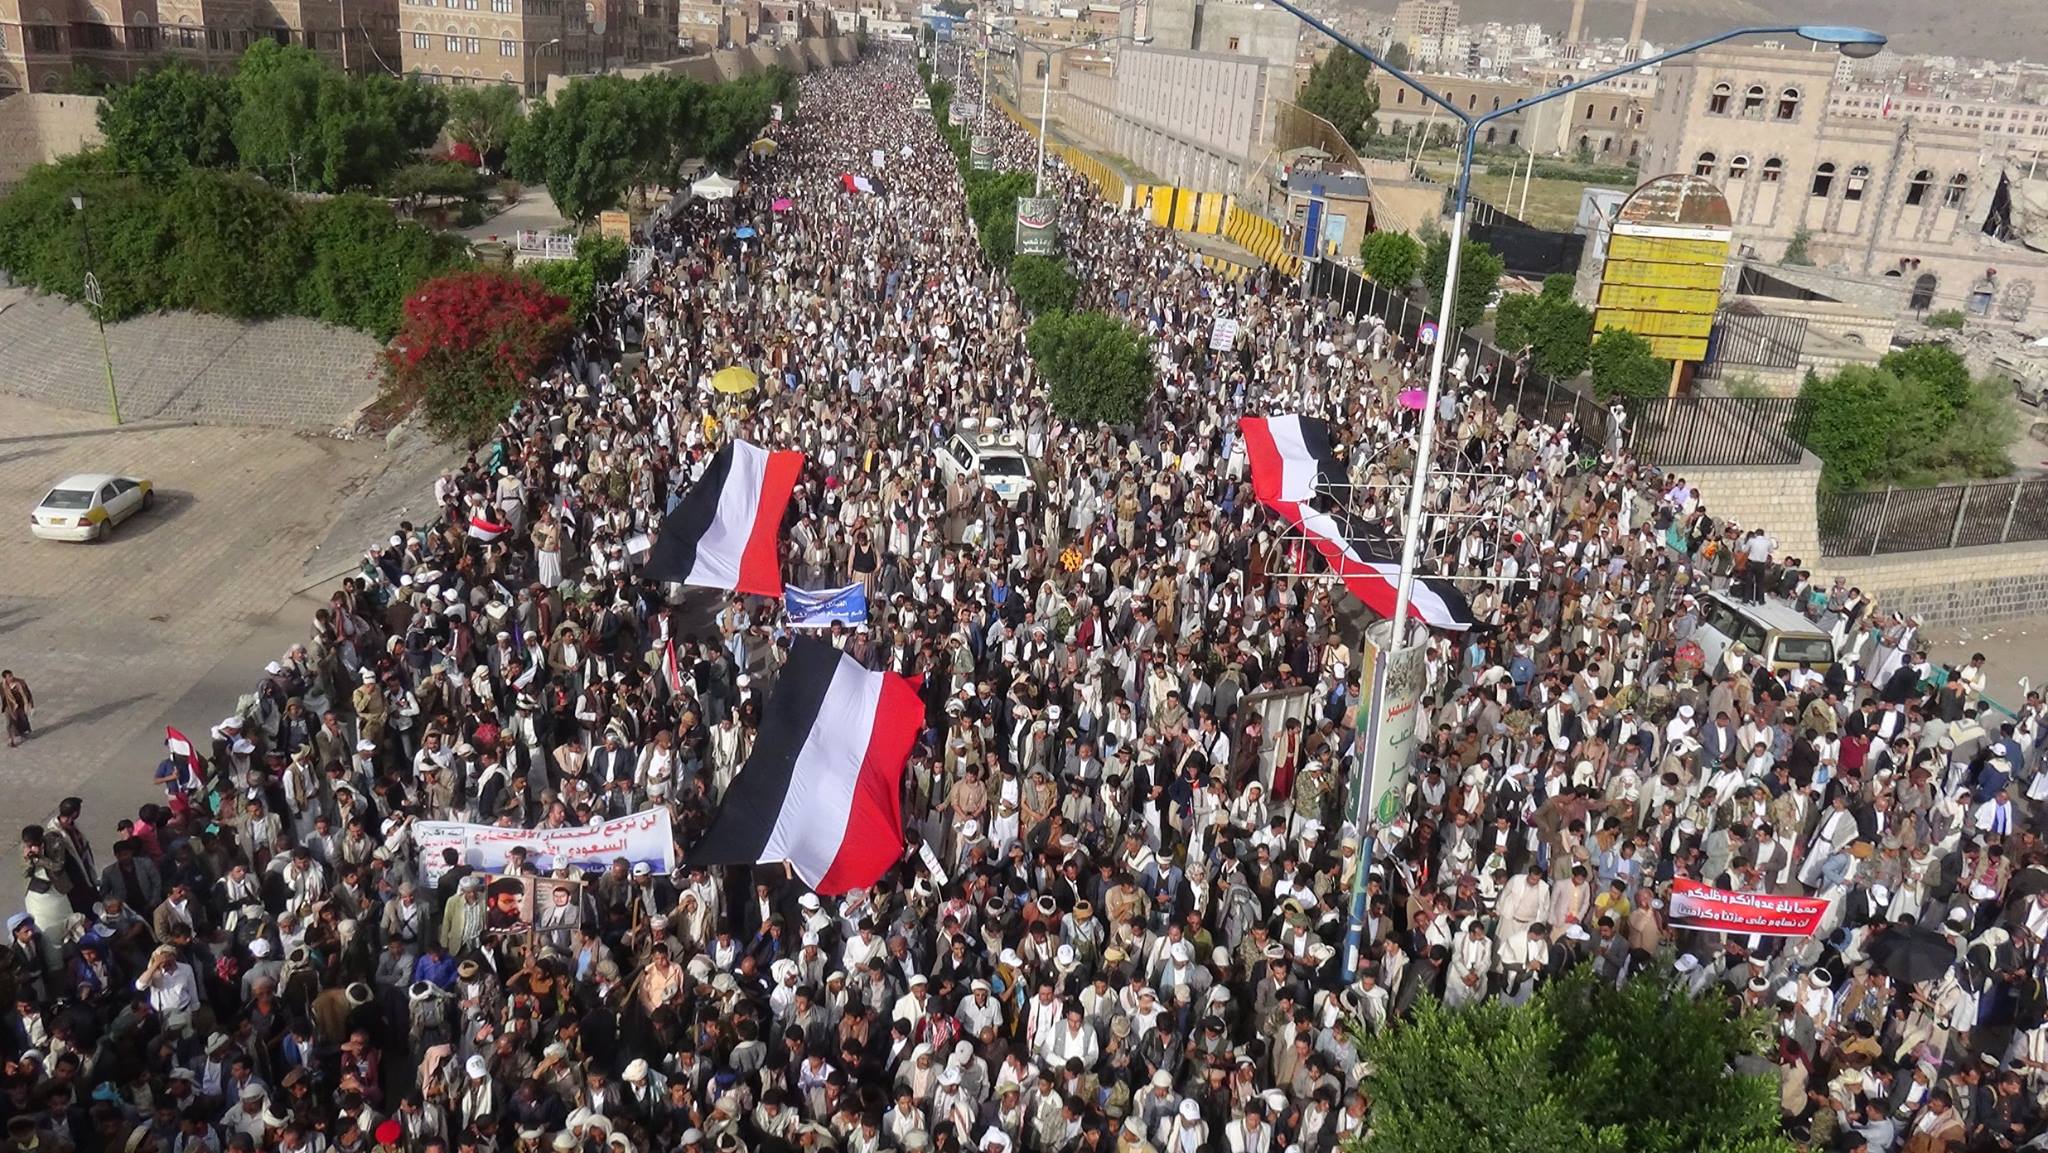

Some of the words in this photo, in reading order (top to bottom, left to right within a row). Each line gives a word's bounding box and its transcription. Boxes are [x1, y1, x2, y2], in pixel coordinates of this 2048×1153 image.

[604, 818, 636, 837] نركع
[640, 814, 657, 831] لن
[543, 826, 600, 842] للحصار
[567, 838, 628, 860] السعودي
[1729, 894, 1774, 910] عدوانكم
[1776, 900, 1793, 915] بلغ
[1794, 901, 1818, 914] مهما
[1678, 903, 1721, 921] وكرامتنا
[1721, 910, 1745, 924] عزتنا
[1745, 915, 1768, 927] على
[1768, 918, 1797, 927] نساوم
[1797, 918, 1810, 927] لن
